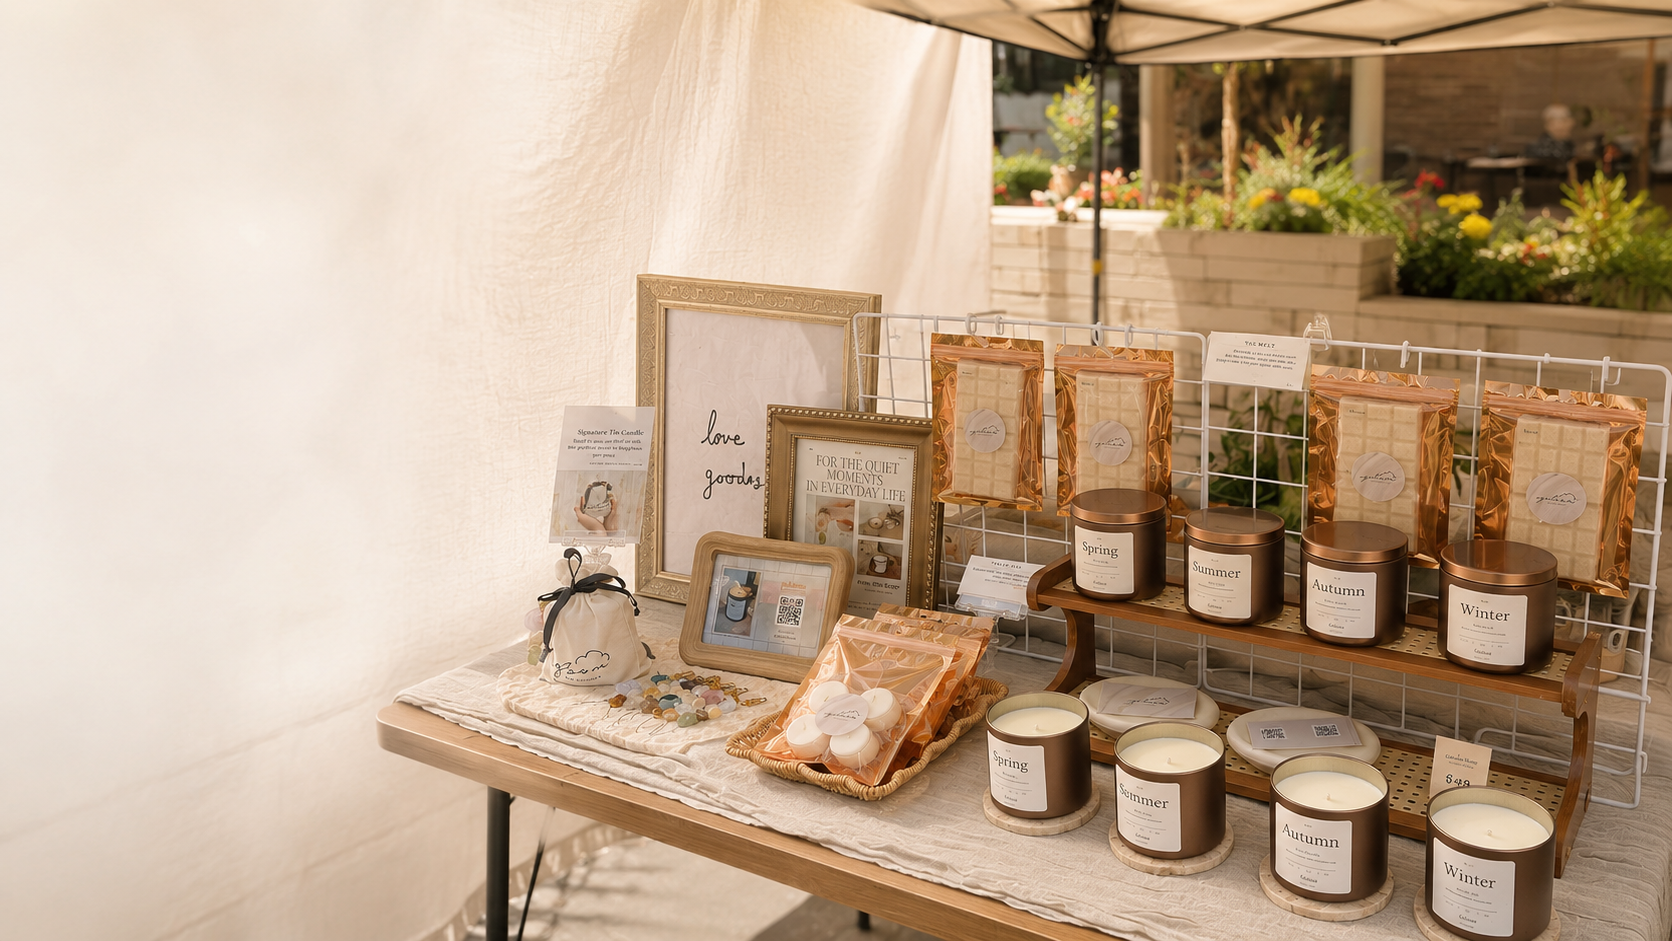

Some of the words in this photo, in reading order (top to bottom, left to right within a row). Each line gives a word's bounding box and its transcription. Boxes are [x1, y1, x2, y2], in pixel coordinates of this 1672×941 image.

[700, 409, 746, 446] love
[816, 454, 838, 468] FOR
[840, 456, 863, 471] THE
[865, 459, 900, 475] QUIET
[827, 468, 884, 486] MOMENTS
[806, 479, 819, 492] IN
[821, 481, 880, 499] EVERYDAY
[882, 488, 906, 502] LIFE
[1082, 541, 1119, 559] Spring
[1192, 560, 1241, 579] Summer
[1312, 578, 1366, 597] Autumn
[1460, 602, 1511, 622] Winter
[993, 750, 1029, 774] Spring
[1282, 823, 1340, 849] Autumn
[1443, 861, 1497, 889] Winter
